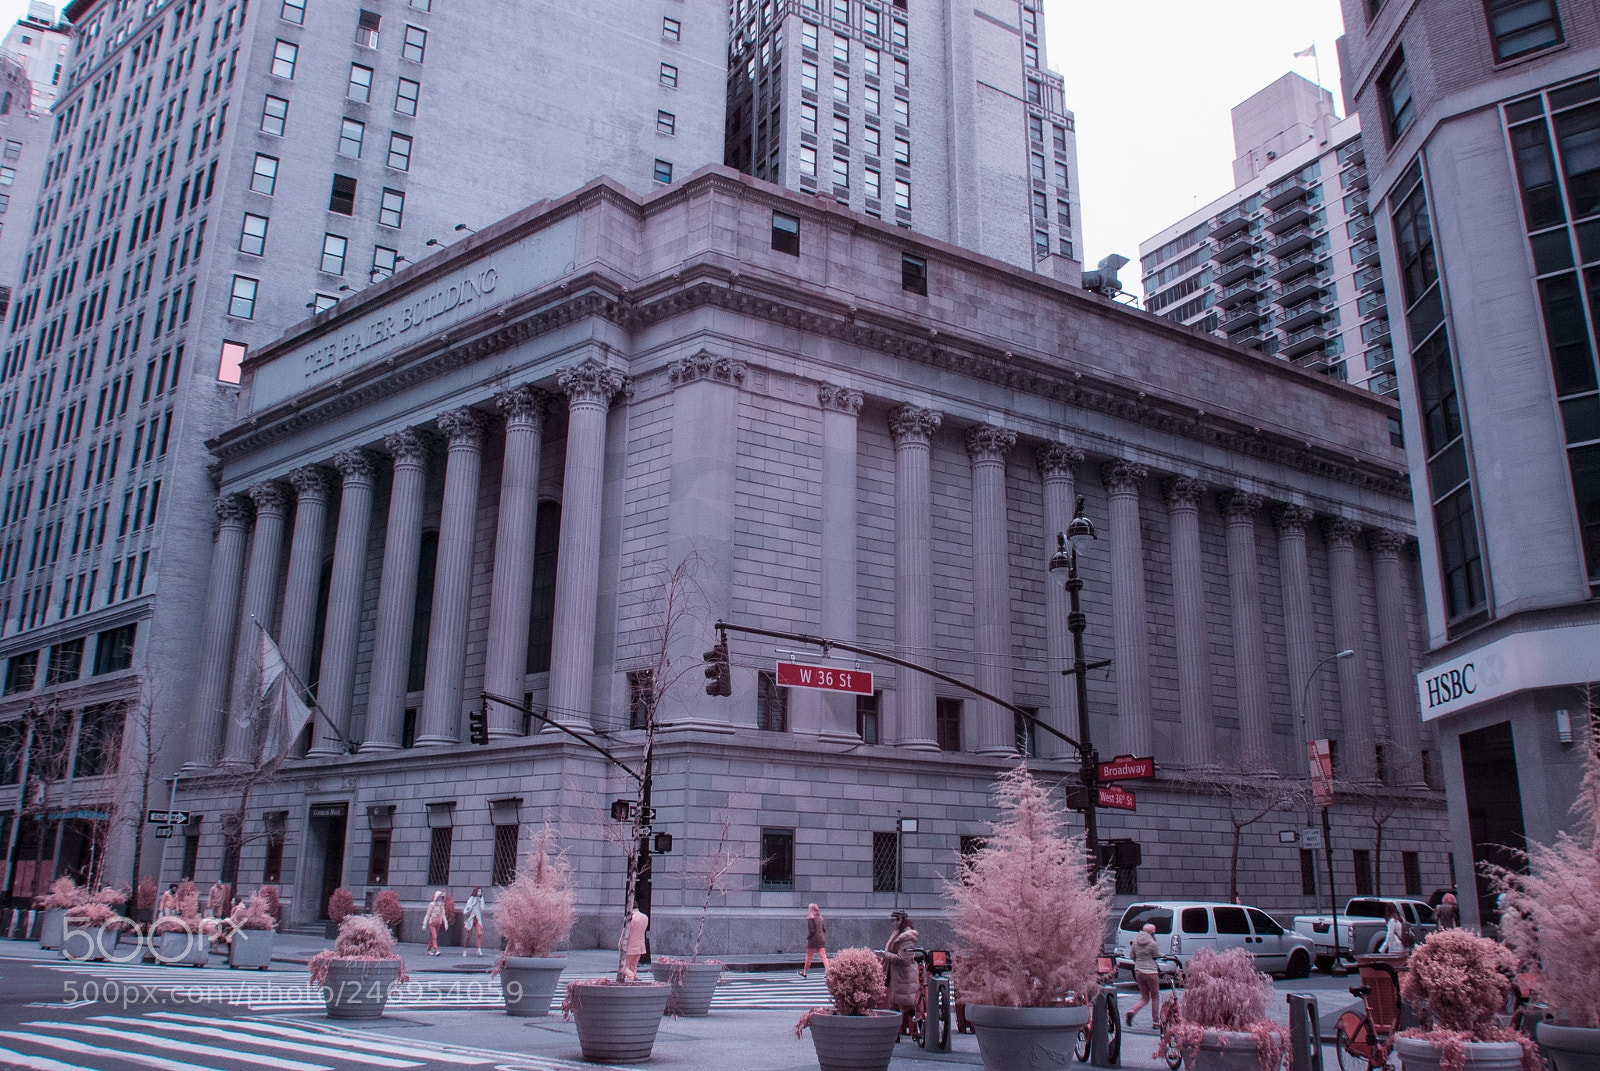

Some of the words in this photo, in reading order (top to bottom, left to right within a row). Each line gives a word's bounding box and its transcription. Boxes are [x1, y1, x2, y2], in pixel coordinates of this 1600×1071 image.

[305, 343, 337, 377] THE
[338, 317, 396, 360] HAIER
[399, 267, 498, 333] BUILDING
[800, 669, 811, 683] W
[818, 671, 833, 686] 36
[839, 673, 852, 688] St
[1426, 663, 1477, 708] HSBC
[1103, 764, 1146, 777] Broadway
[1099, 791, 1114, 804] West
[1126, 796, 1133, 806] St
